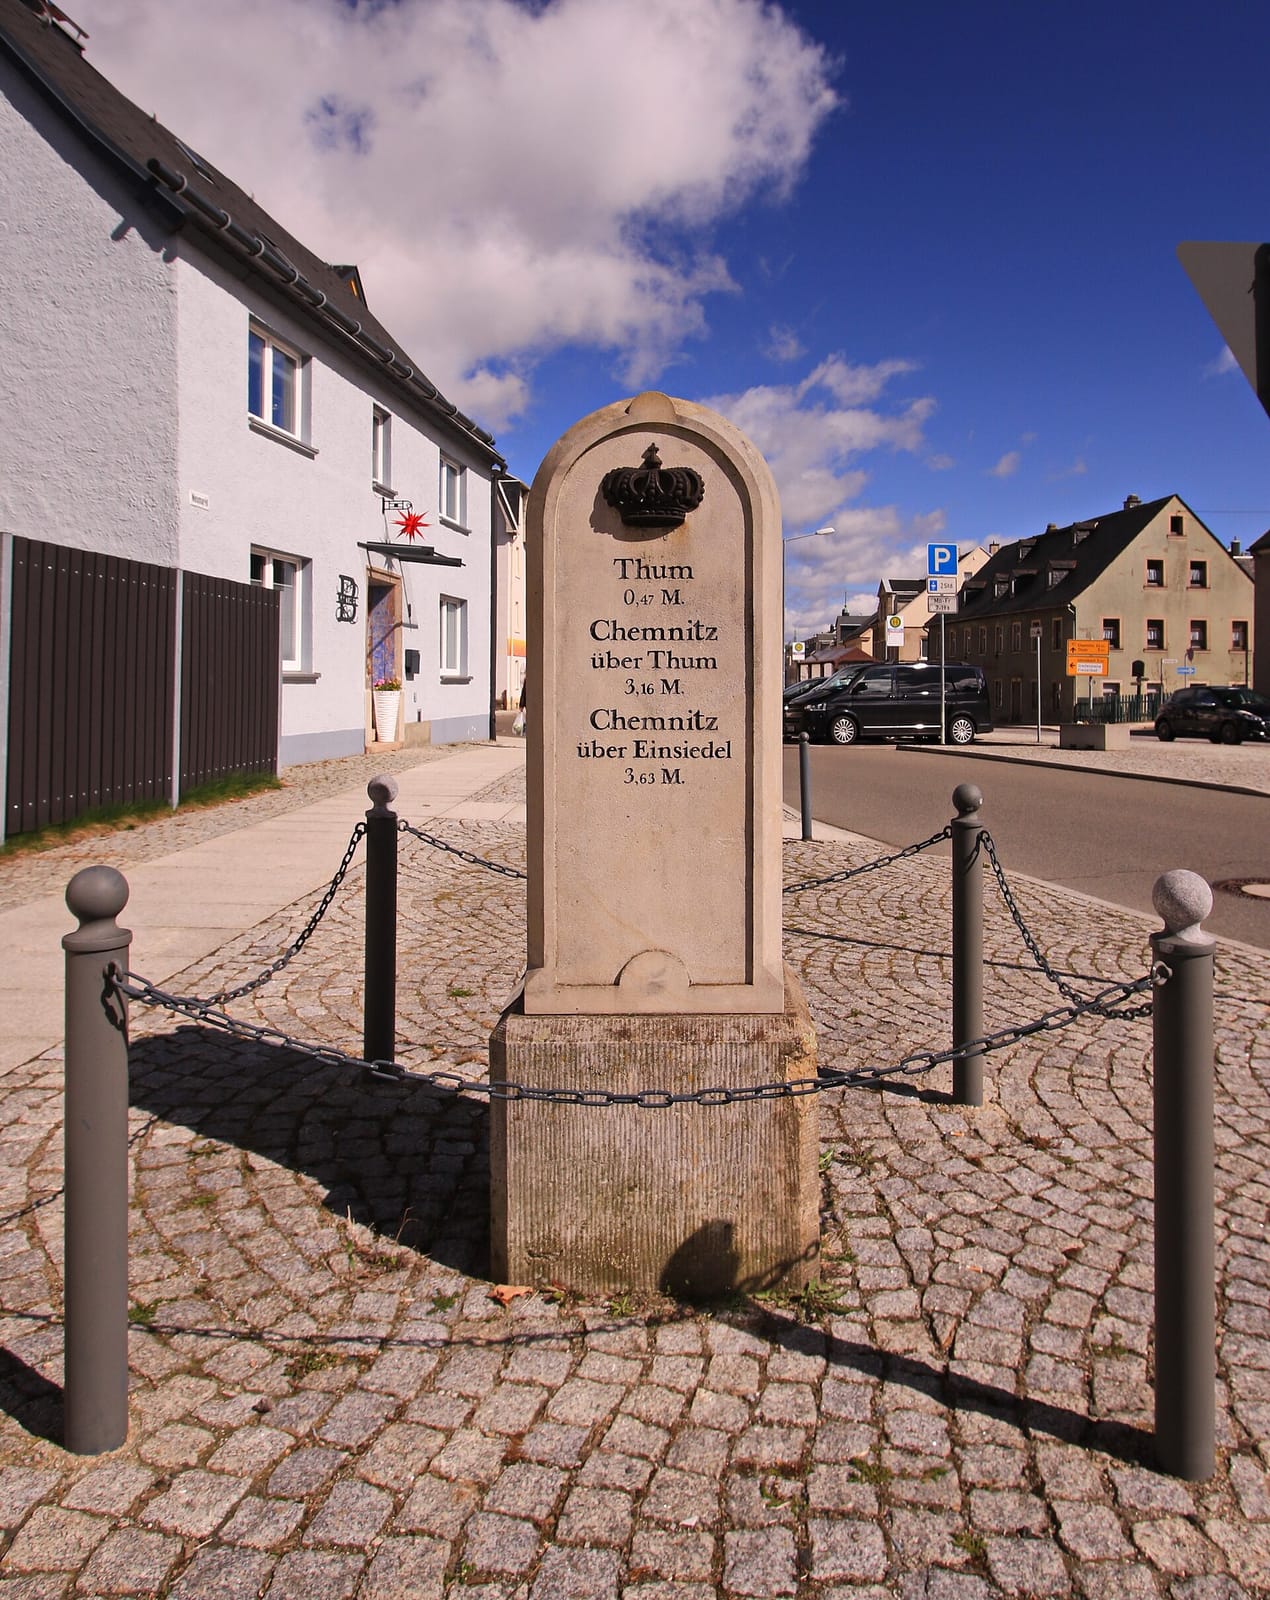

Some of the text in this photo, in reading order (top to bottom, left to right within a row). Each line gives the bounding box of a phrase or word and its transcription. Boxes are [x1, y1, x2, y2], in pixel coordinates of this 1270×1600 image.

[613, 558, 694, 580] Thum
[934, 547, 951, 572] P
[624, 589, 685, 607] 0,47 M.
[590, 620, 718, 641] Chemnitz
[591, 651, 718, 670] über Thum
[624, 679, 684, 696] 3,16 M.
[590, 709, 718, 731] Chemnitz
[576, 740, 732, 759] über Einsiedel
[624, 768, 685, 785] 3,63 M.
